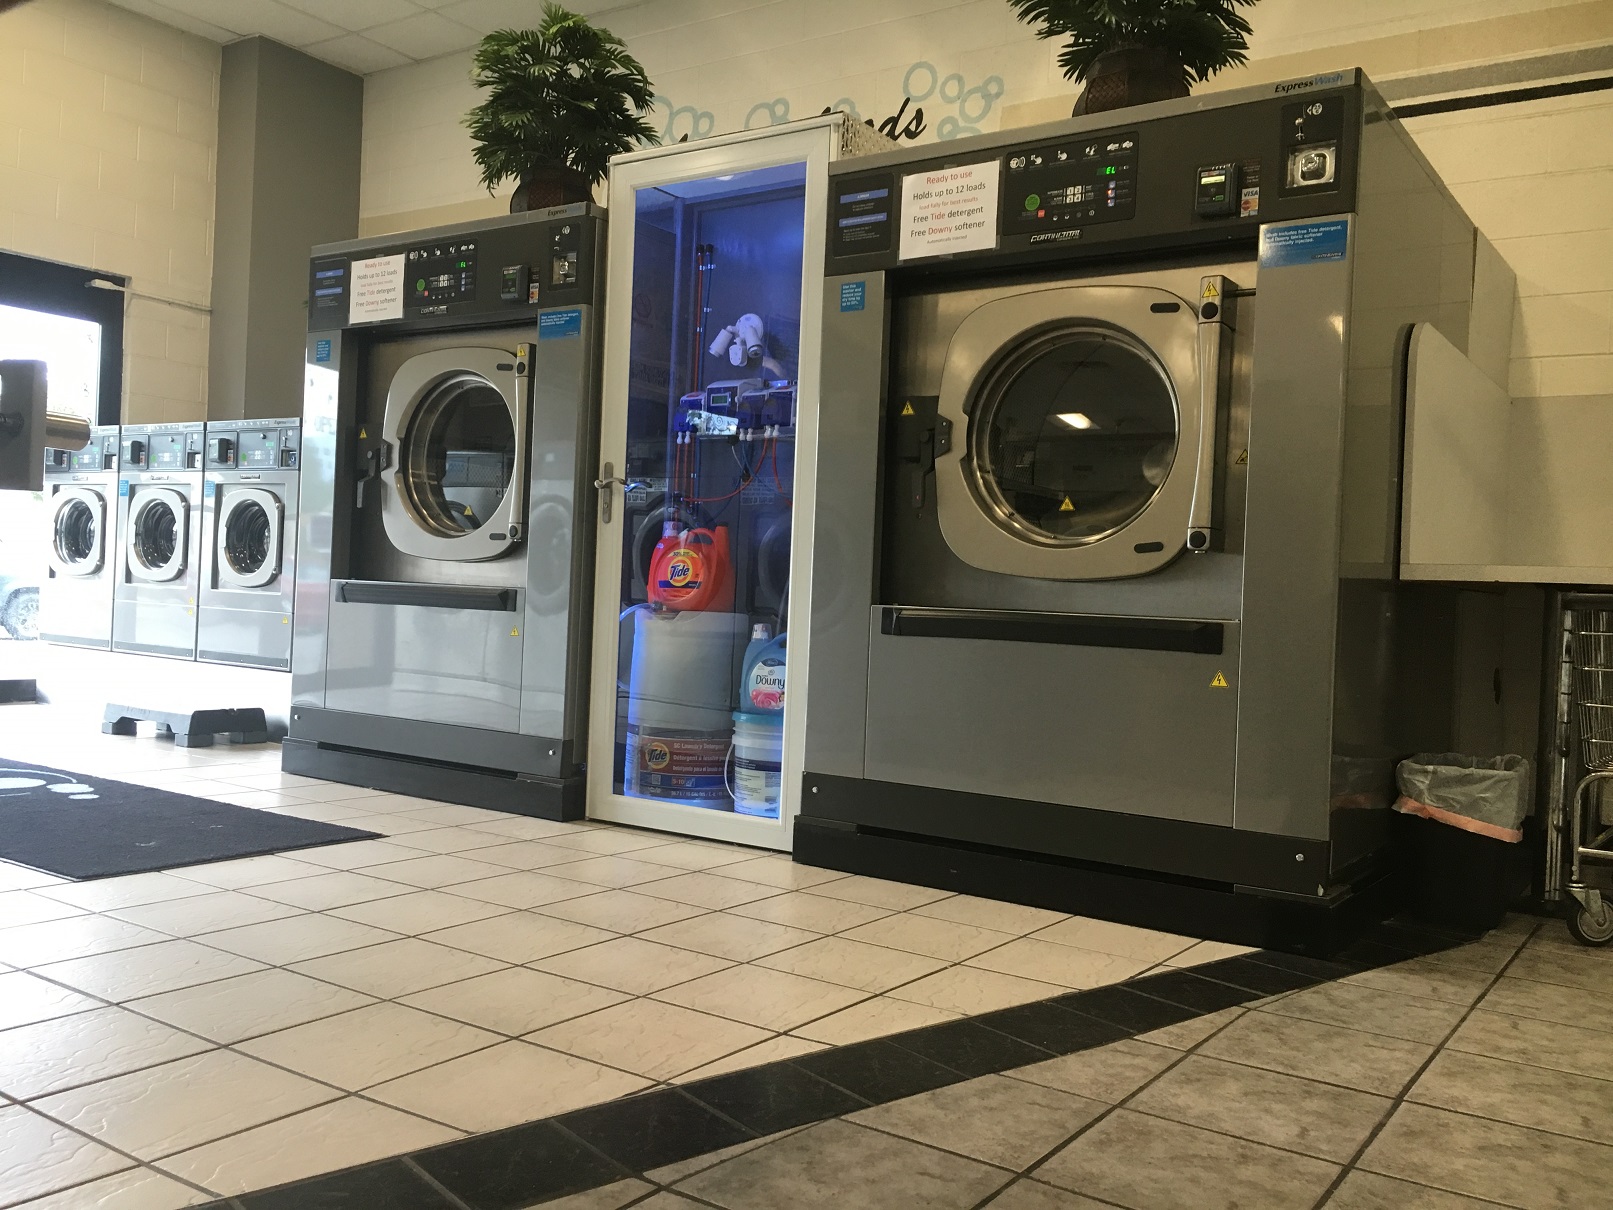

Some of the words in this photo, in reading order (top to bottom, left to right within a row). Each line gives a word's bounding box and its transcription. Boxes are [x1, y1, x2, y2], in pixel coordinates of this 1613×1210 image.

[926, 175, 948, 184] Ready
[913, 191, 933, 200] Holds
[956, 185, 964, 194] 12
[966, 182, 986, 192] loads
[913, 215, 928, 223] Free
[931, 212, 945, 220] Tide
[947, 206, 983, 218] detergent
[911, 229, 926, 237] Free
[928, 225, 952, 235] Downy
[954, 220, 985, 231] softener
[670, 564, 690, 580] Tide
[756, 674, 785, 690] Downy
[648, 749, 667, 762] Tide
